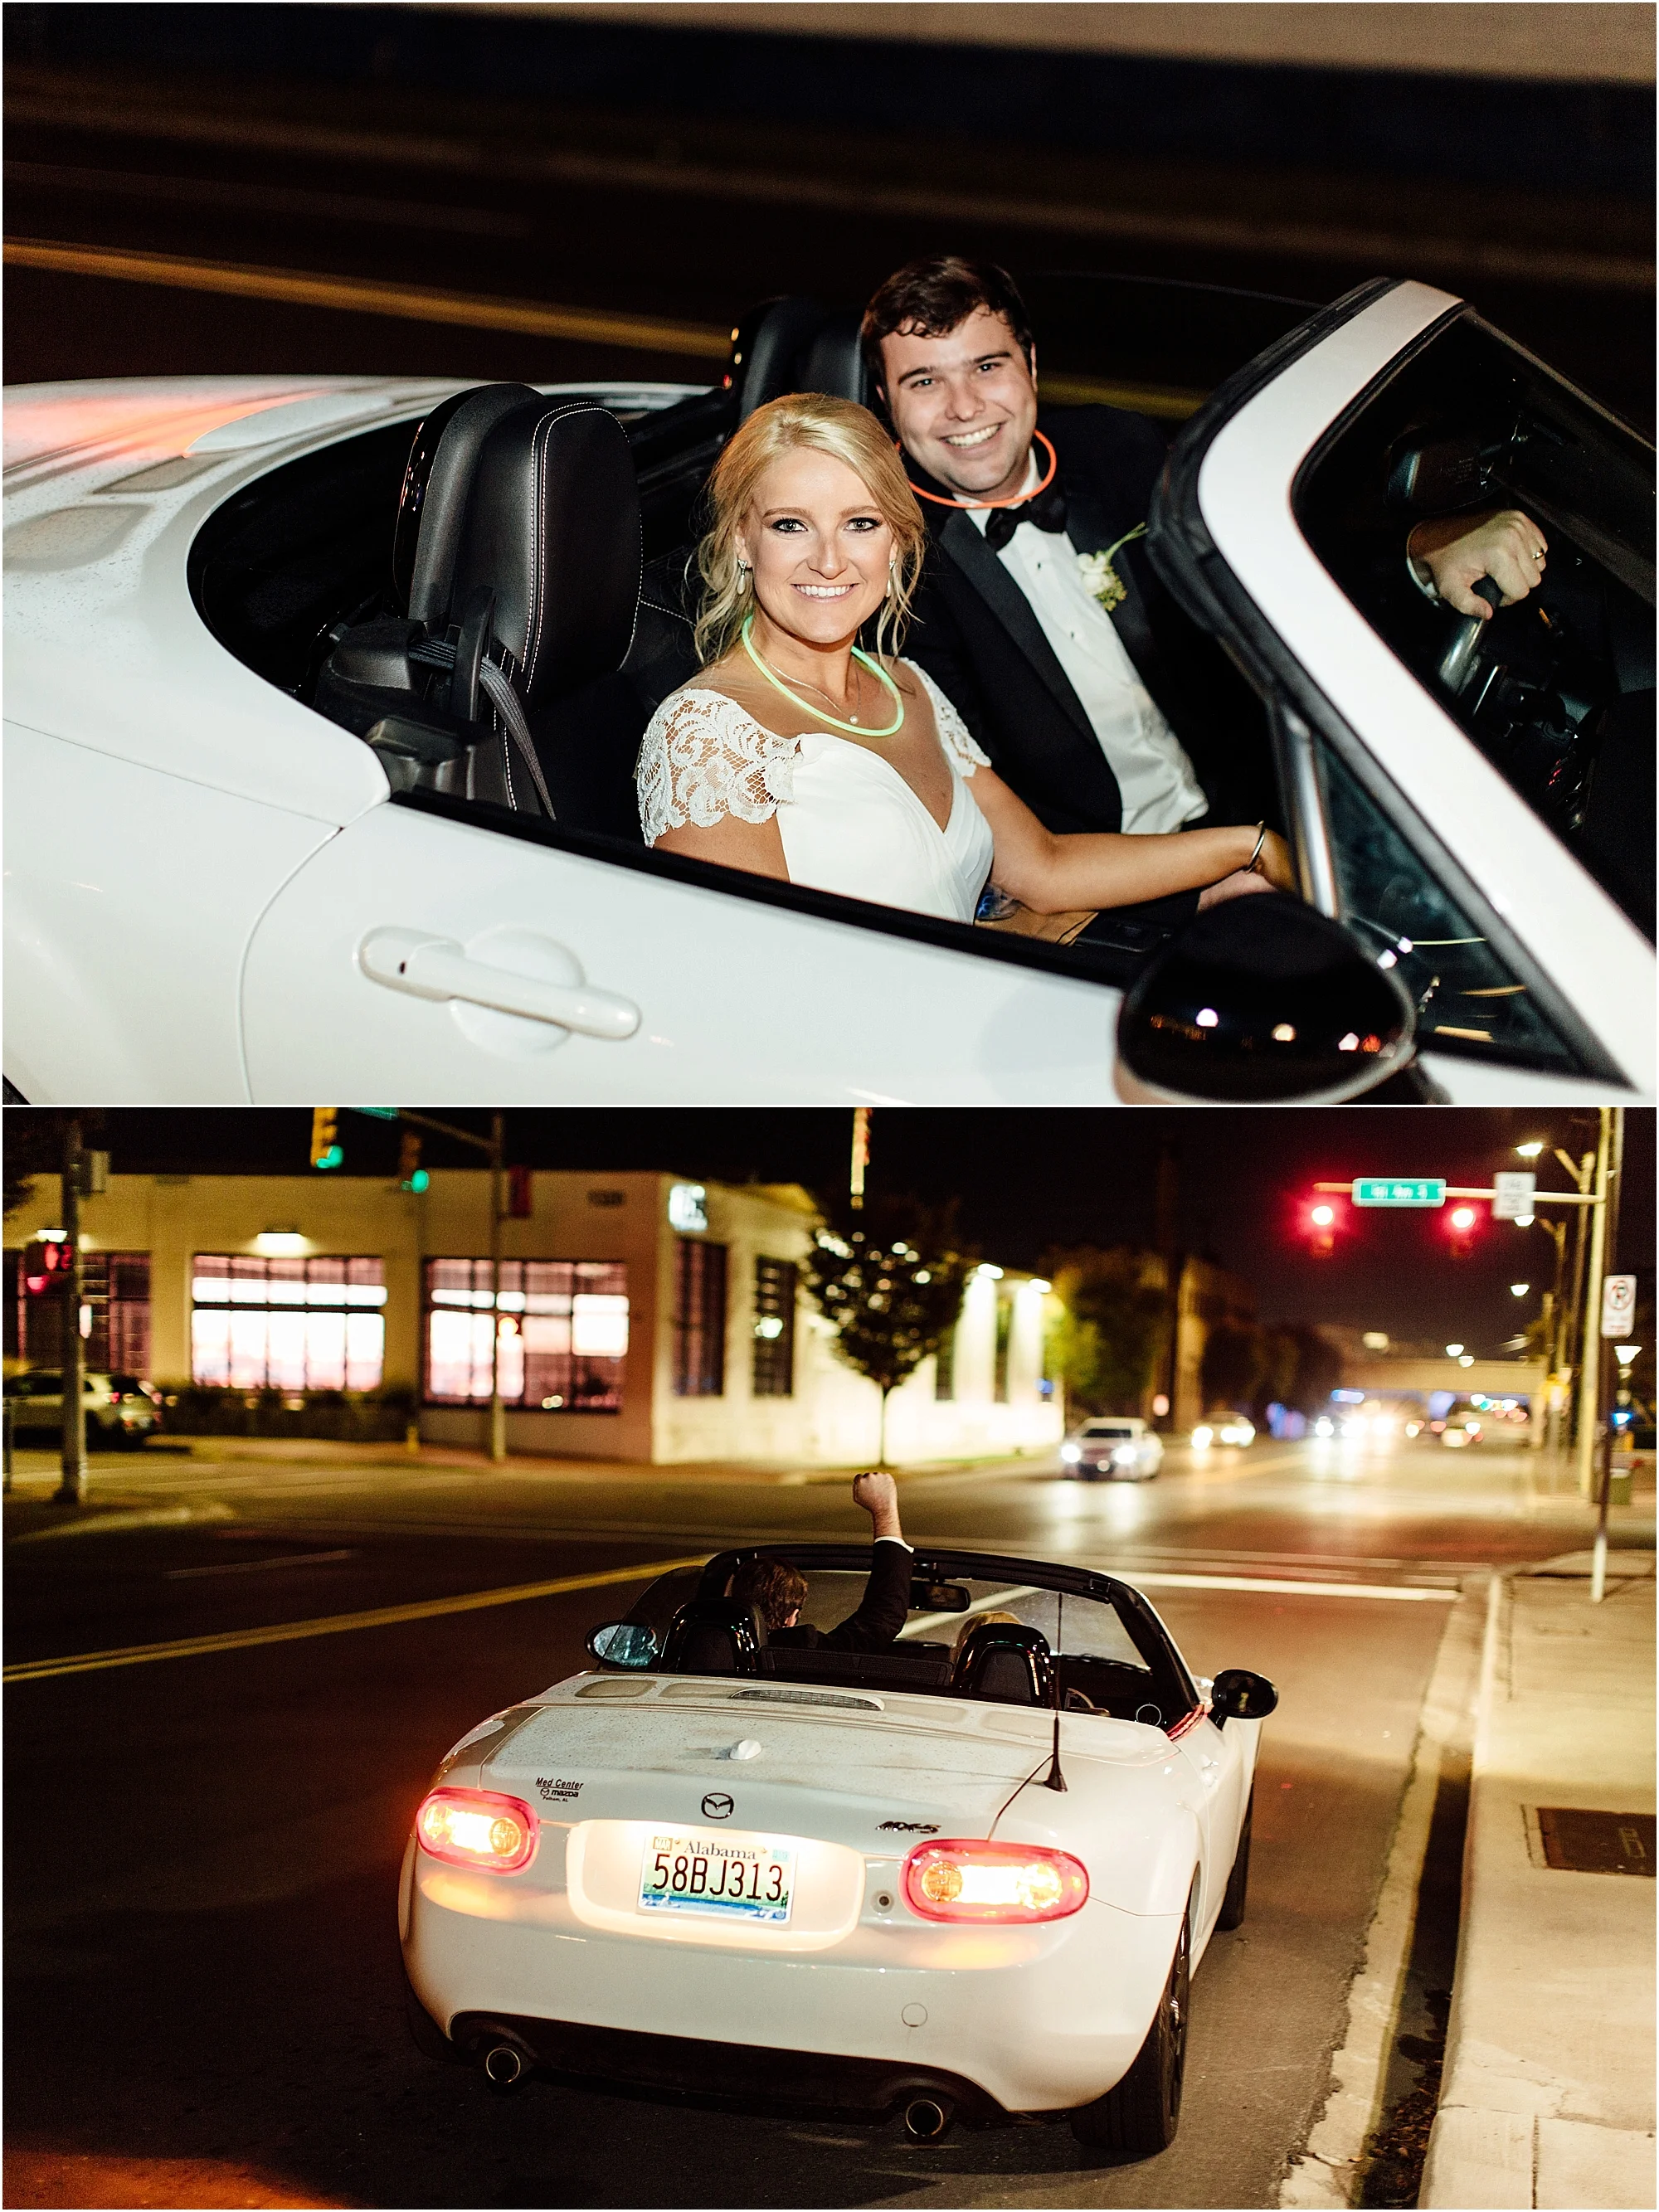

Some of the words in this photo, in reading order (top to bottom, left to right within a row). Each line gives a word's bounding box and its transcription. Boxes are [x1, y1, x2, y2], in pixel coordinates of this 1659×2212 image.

[536, 1777, 553, 1787] Med
[556, 1779, 584, 1789] Center
[684, 1840, 757, 1860] Alabama
[652, 1853, 783, 1901] 58BJ313
